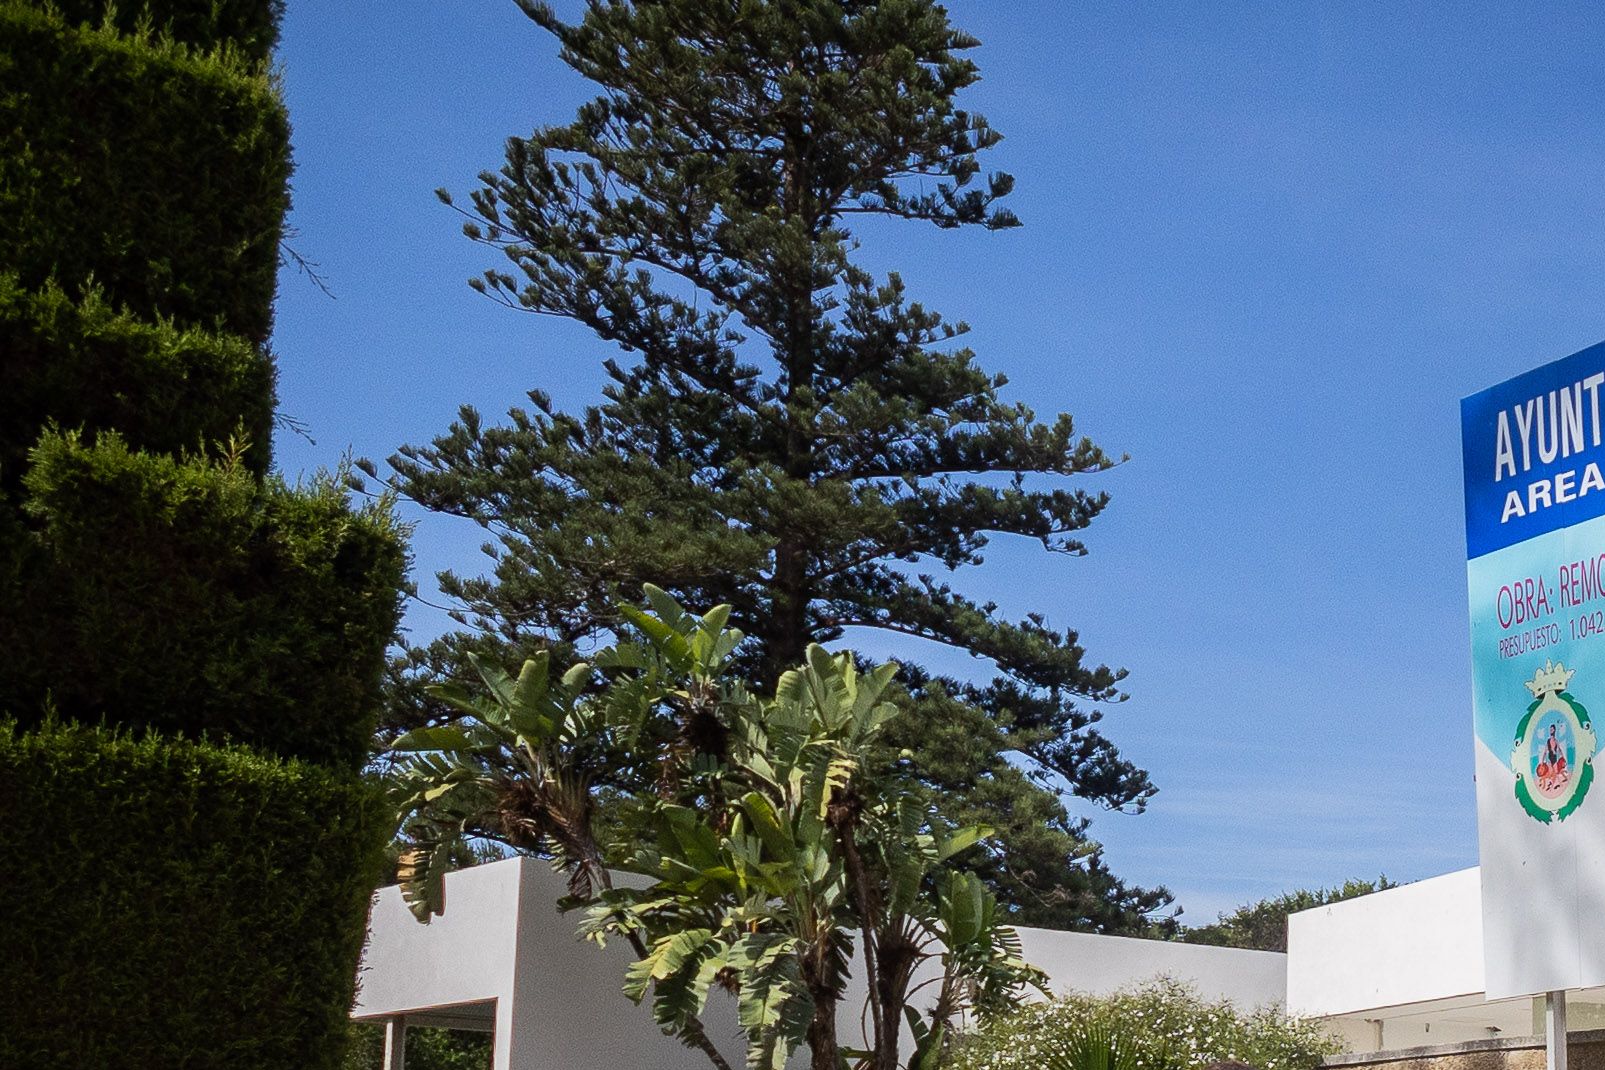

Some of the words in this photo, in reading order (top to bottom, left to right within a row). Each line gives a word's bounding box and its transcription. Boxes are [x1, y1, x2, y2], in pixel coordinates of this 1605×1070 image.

[1501, 462, 1605, 523] AREA
[1497, 575, 1554, 629] OBRA:
[1499, 622, 1562, 659] PRESUPUESTO:
